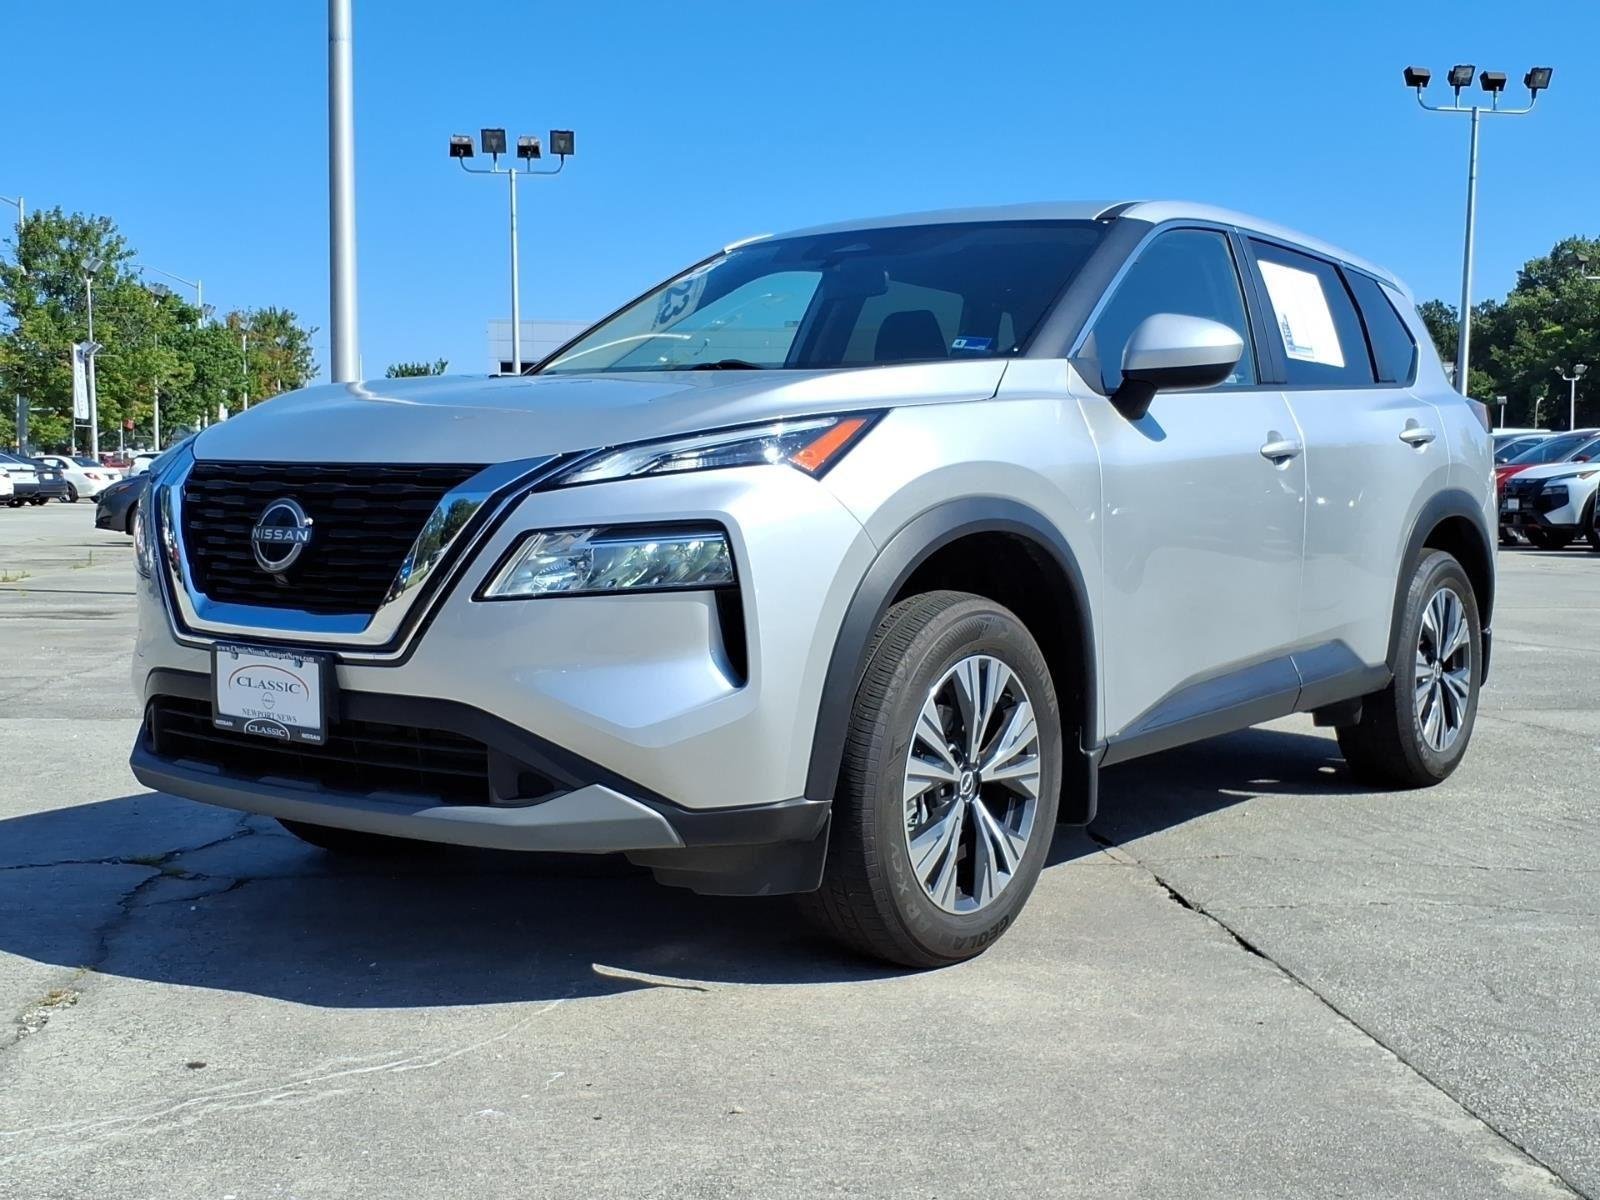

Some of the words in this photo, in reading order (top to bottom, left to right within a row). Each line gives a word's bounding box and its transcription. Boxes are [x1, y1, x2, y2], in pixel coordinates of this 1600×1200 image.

[252, 527, 308, 542] NISSAN
[236, 676, 301, 694] CLASSIC
[242, 708, 277, 720] NEWPORT
[278, 712, 297, 723] NEWS
[248, 724, 285, 737] CLASSIC
